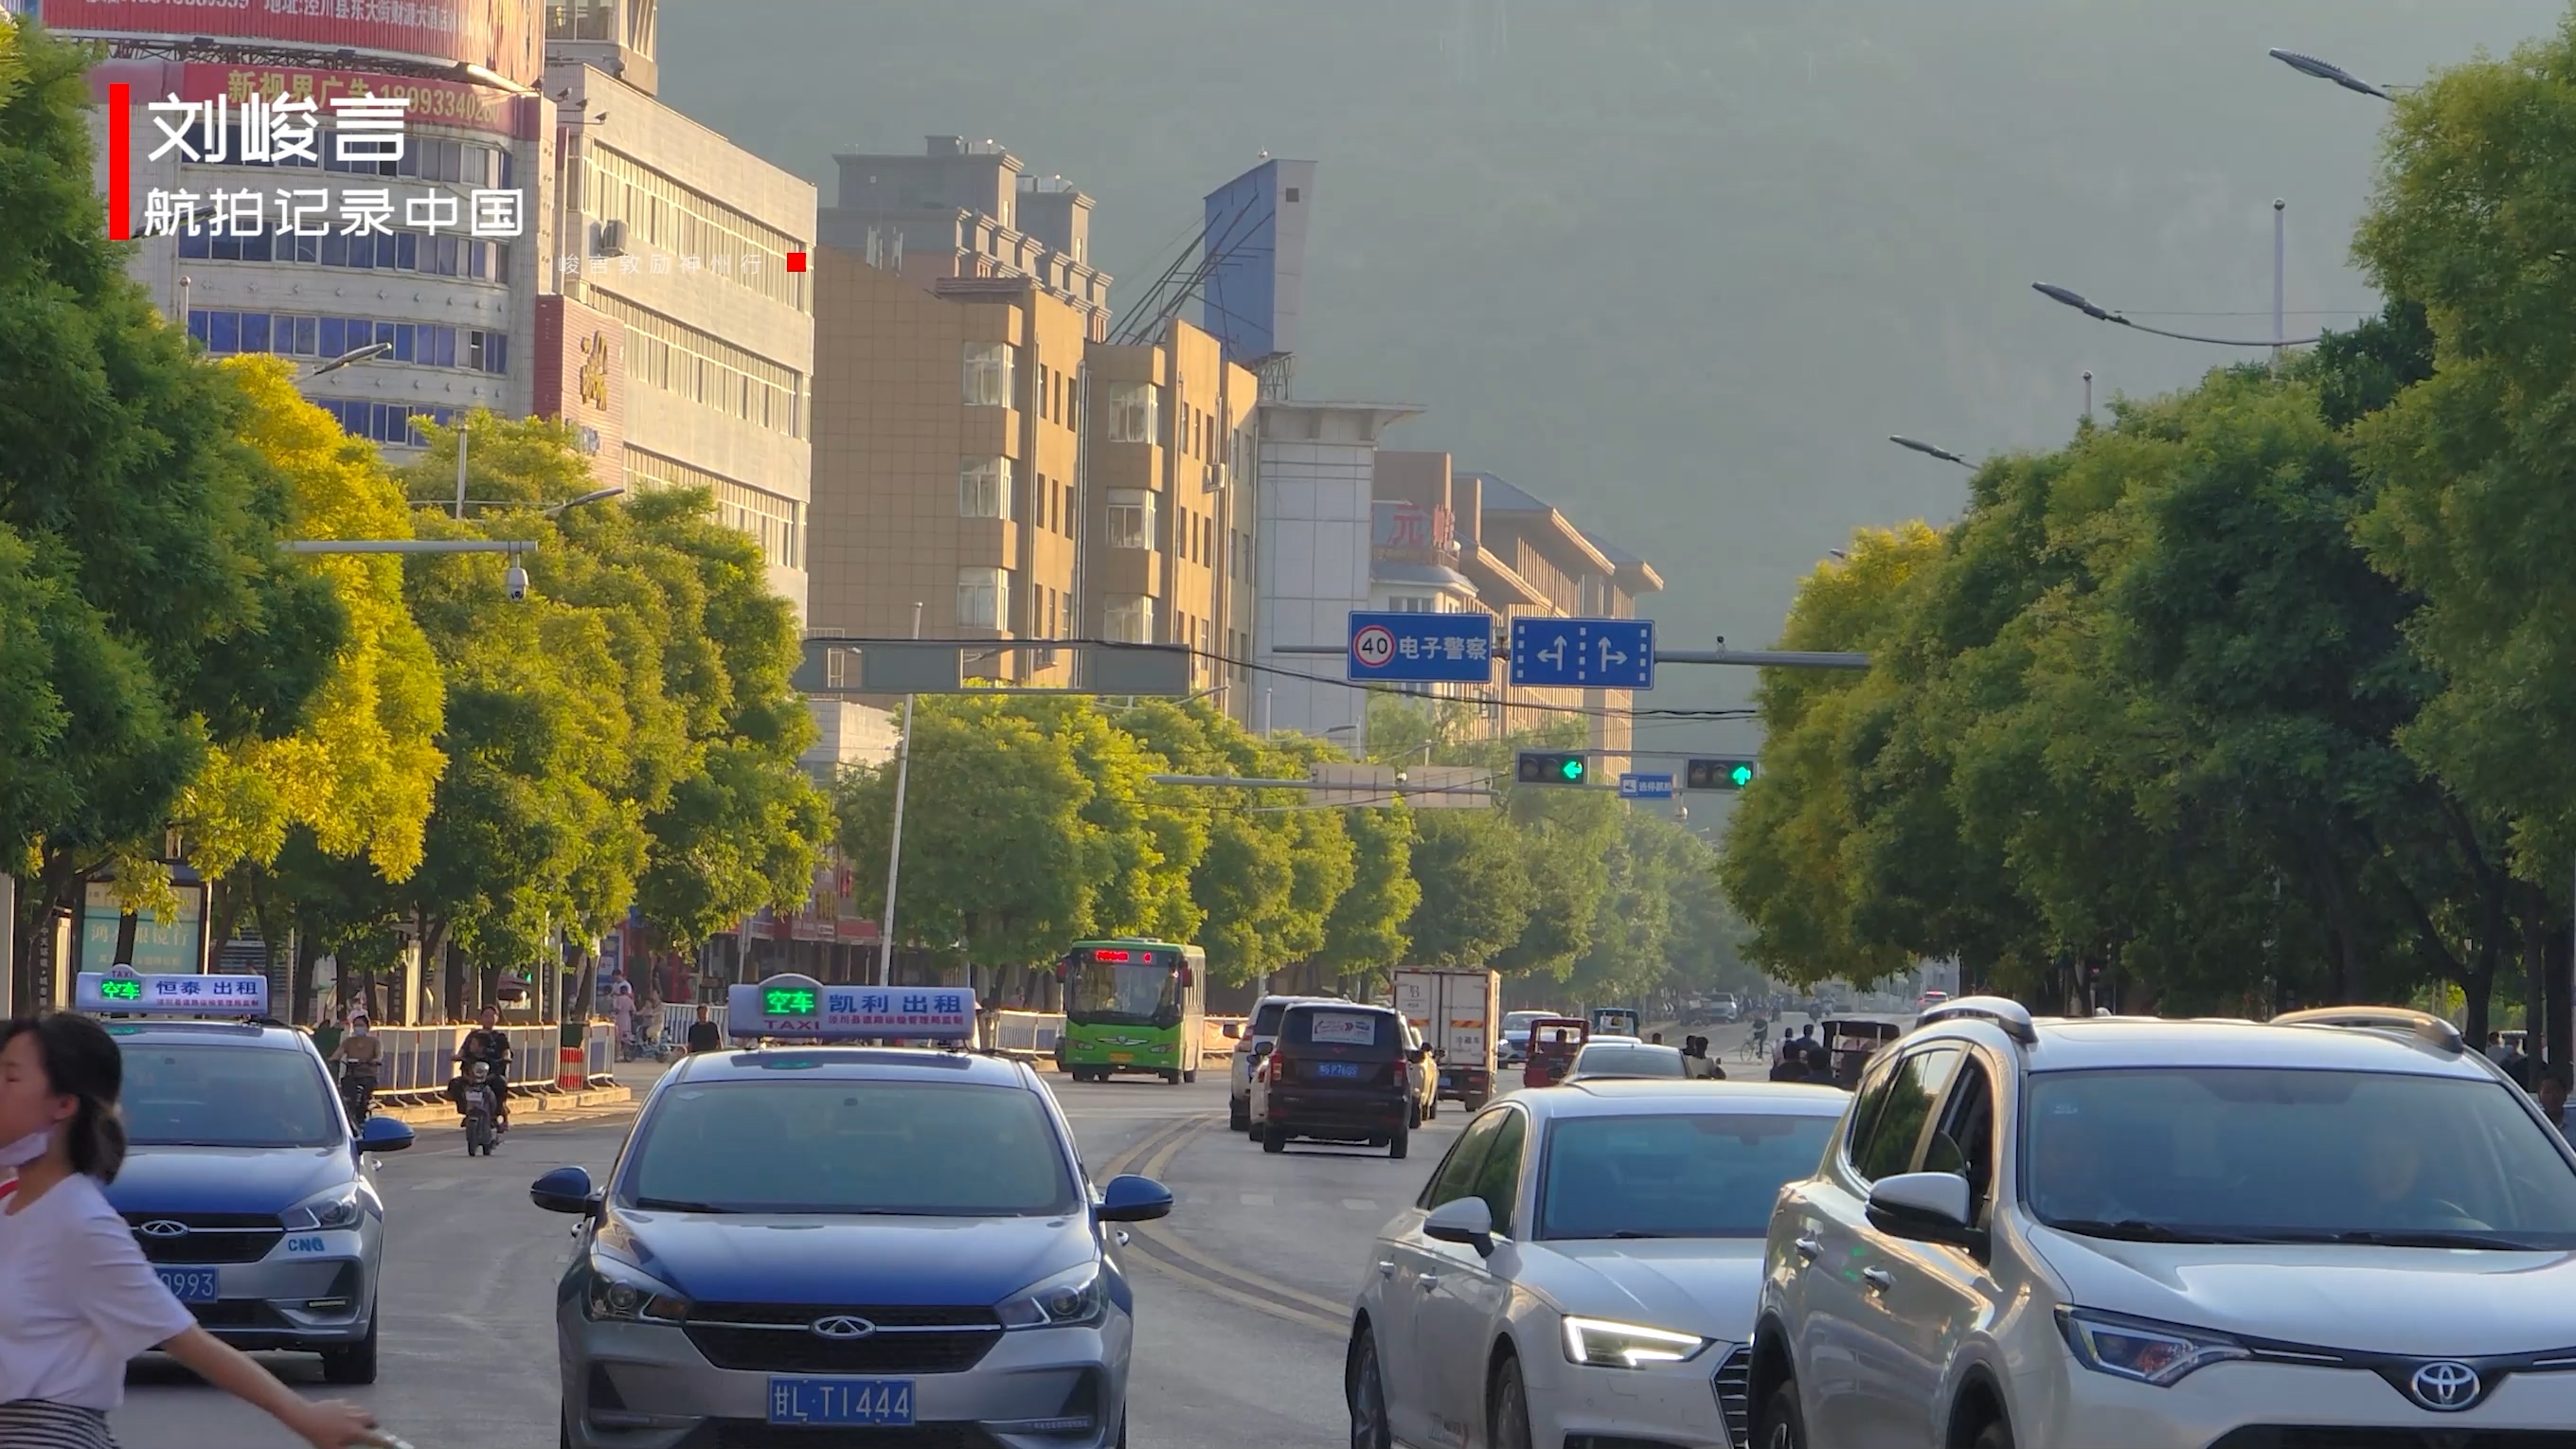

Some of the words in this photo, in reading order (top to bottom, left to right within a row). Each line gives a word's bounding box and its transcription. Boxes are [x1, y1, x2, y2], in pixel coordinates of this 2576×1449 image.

[228, 69, 369, 111] 新视界广告
[1362, 638, 1388, 655] 40
[1399, 636, 1488, 661] 电子警察
[91, 923, 189, 947] 鸿眼镜行
[112, 970, 133, 978] TAXI
[101, 981, 140, 1000] 空车
[156, 981, 201, 995] 恒泰
[214, 981, 258, 995] 出租
[767, 991, 814, 1014] 空车
[829, 994, 888, 1013] 凯利
[903, 995, 962, 1014] 出租
[764, 1020, 820, 1030] TAXI
[288, 1237, 325, 1252] CNG
